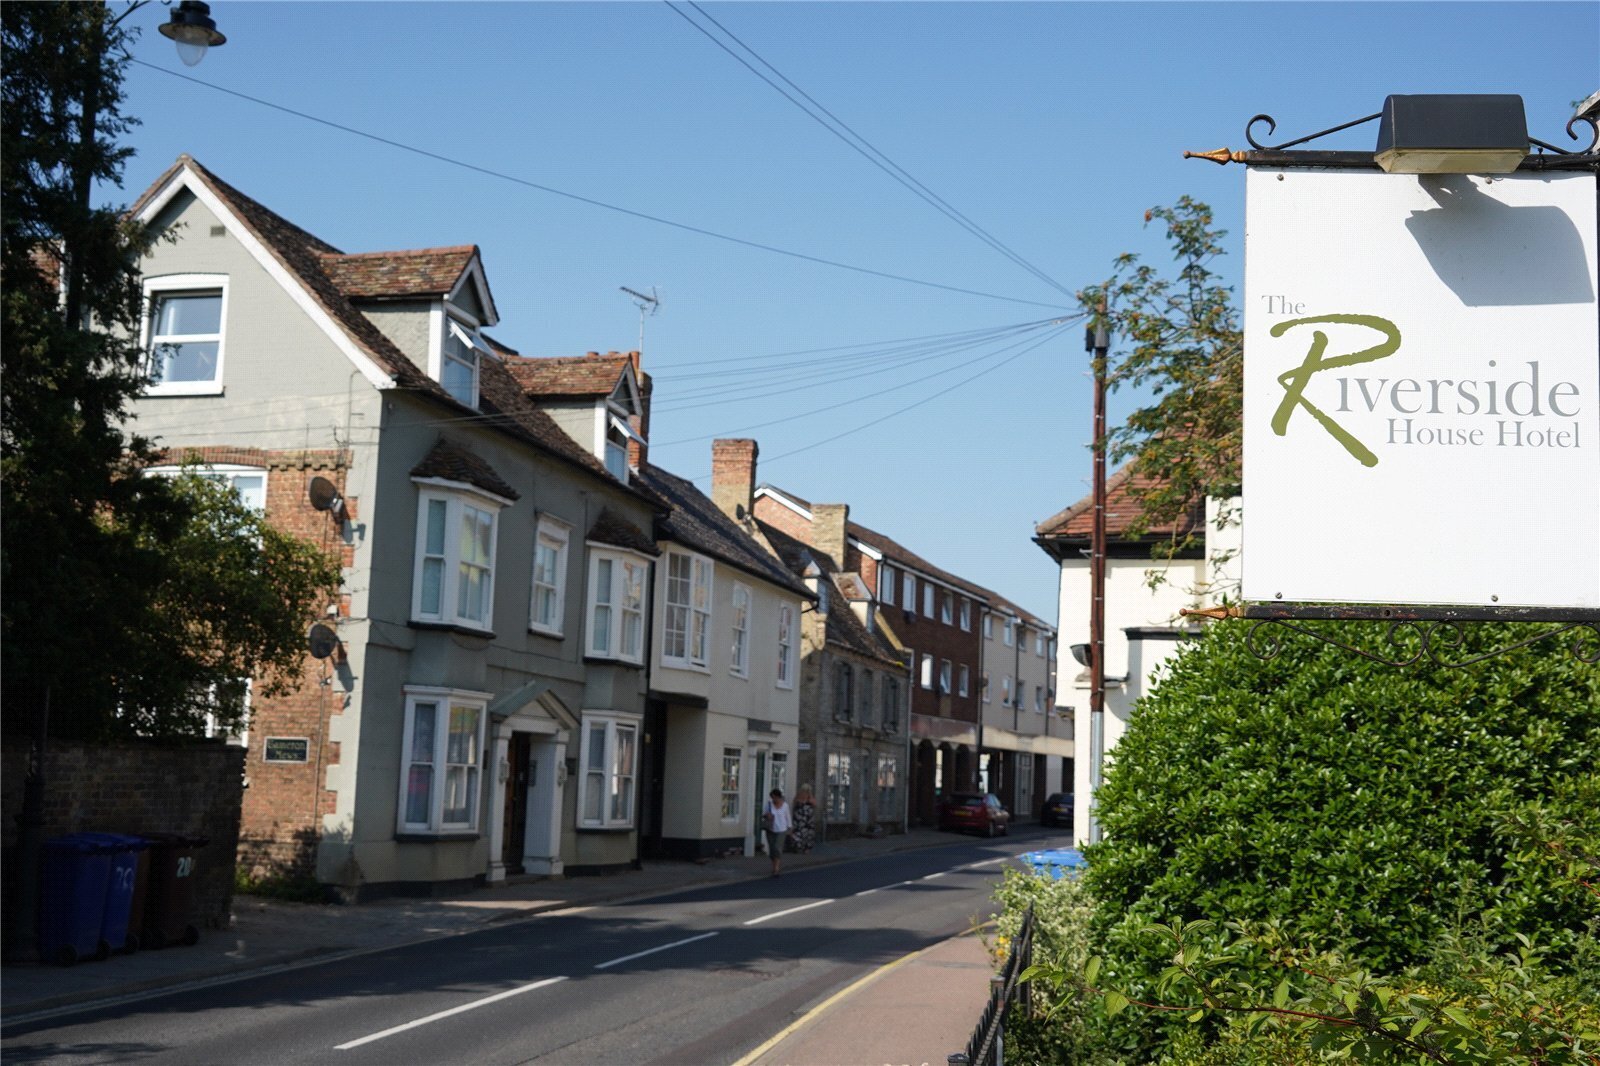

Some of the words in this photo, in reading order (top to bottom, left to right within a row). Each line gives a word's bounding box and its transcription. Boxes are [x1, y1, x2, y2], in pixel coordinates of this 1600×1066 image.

[1262, 295, 1306, 315] The
[1270, 313, 1581, 468] Riverside
[1386, 418, 1484, 446] House
[1495, 421, 1581, 448] Hotel
